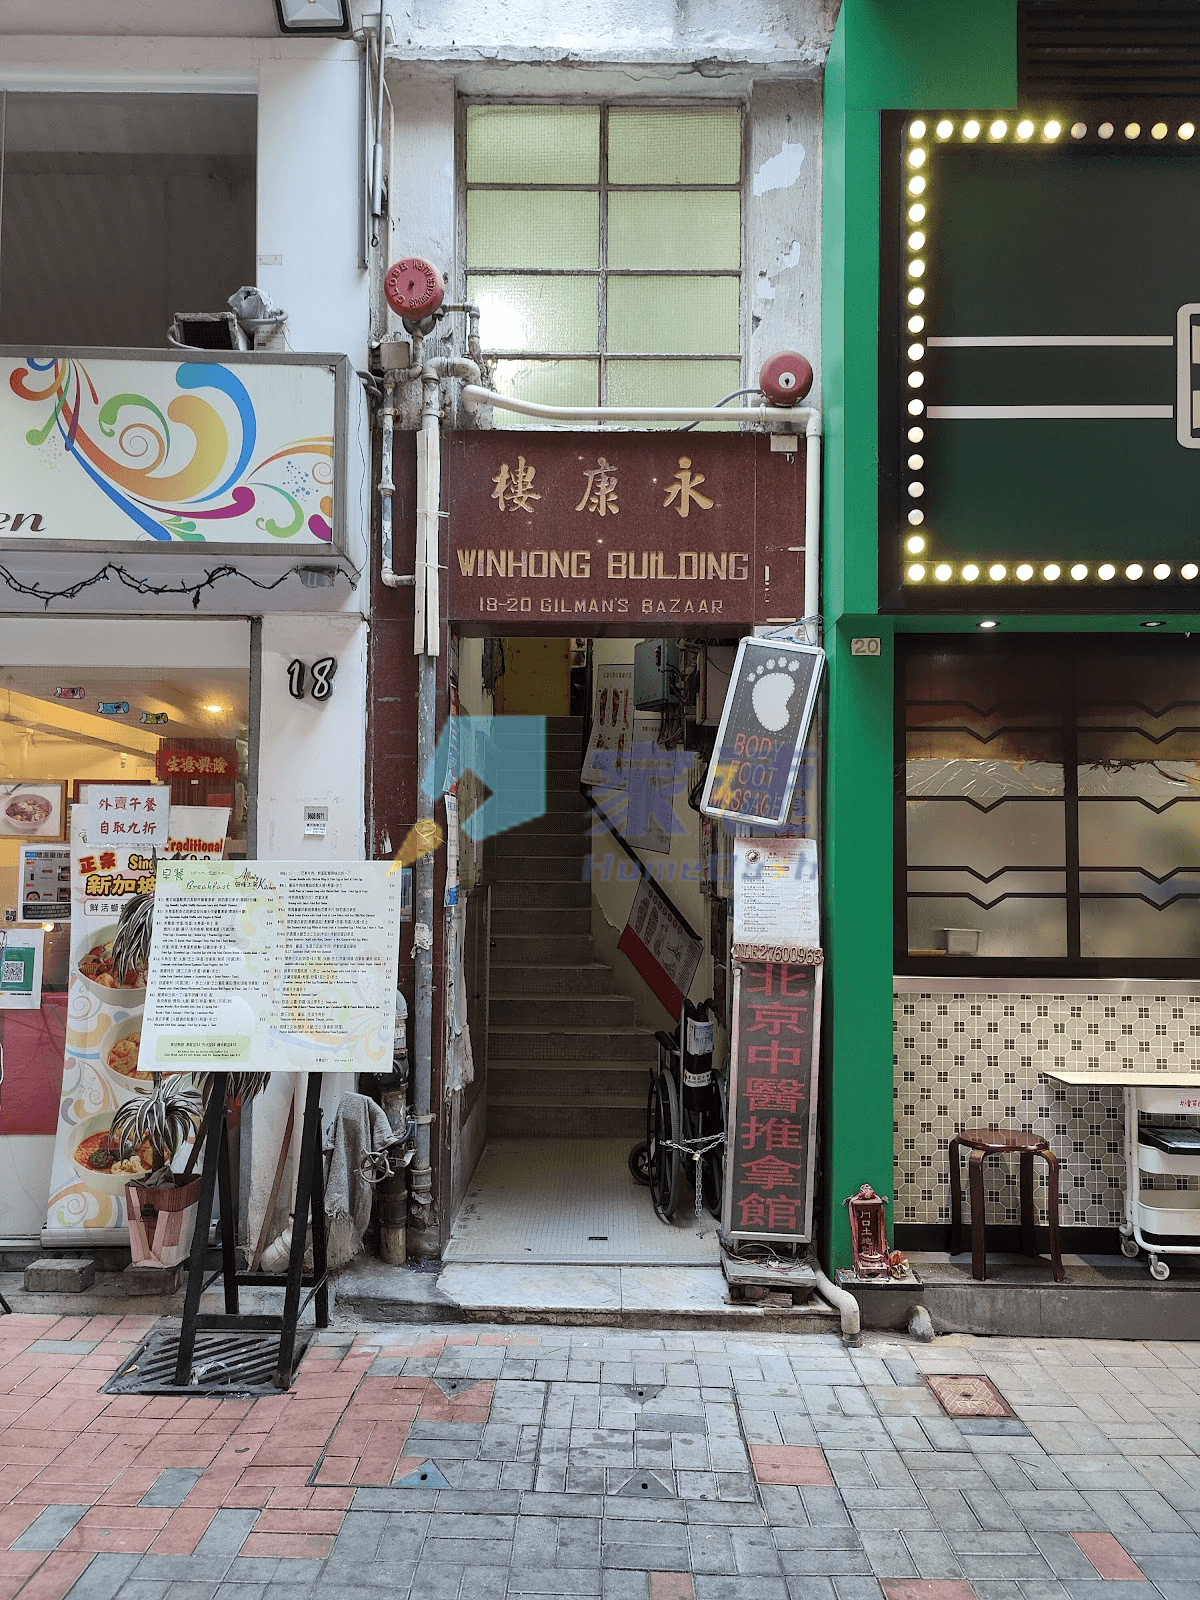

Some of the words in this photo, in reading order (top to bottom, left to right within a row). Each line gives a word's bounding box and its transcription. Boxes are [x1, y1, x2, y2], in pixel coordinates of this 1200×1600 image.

[388, 260, 409, 305] GLOBE
[457, 548, 591, 579] WINHONG
[607, 550, 749, 581] BUILDING
[479, 596, 532, 613] 18-20
[540, 597, 629, 614] GILMAN'S
[642, 599, 723, 615] BAZAAR
[854, 639, 879, 654] 20
[287, 656, 338, 702] 18
[733, 732, 785, 762] BODY
[730, 759, 779, 790] FOOT
[98, 796, 158, 812] 外賣午餐
[99, 820, 158, 836] 自取九折
[79, 852, 117, 875] 正宗
[162, 868, 185, 881] 早餐
[185, 879, 231, 892] Breakfast
[736, 963, 809, 1230] 北京中醫推拿館
